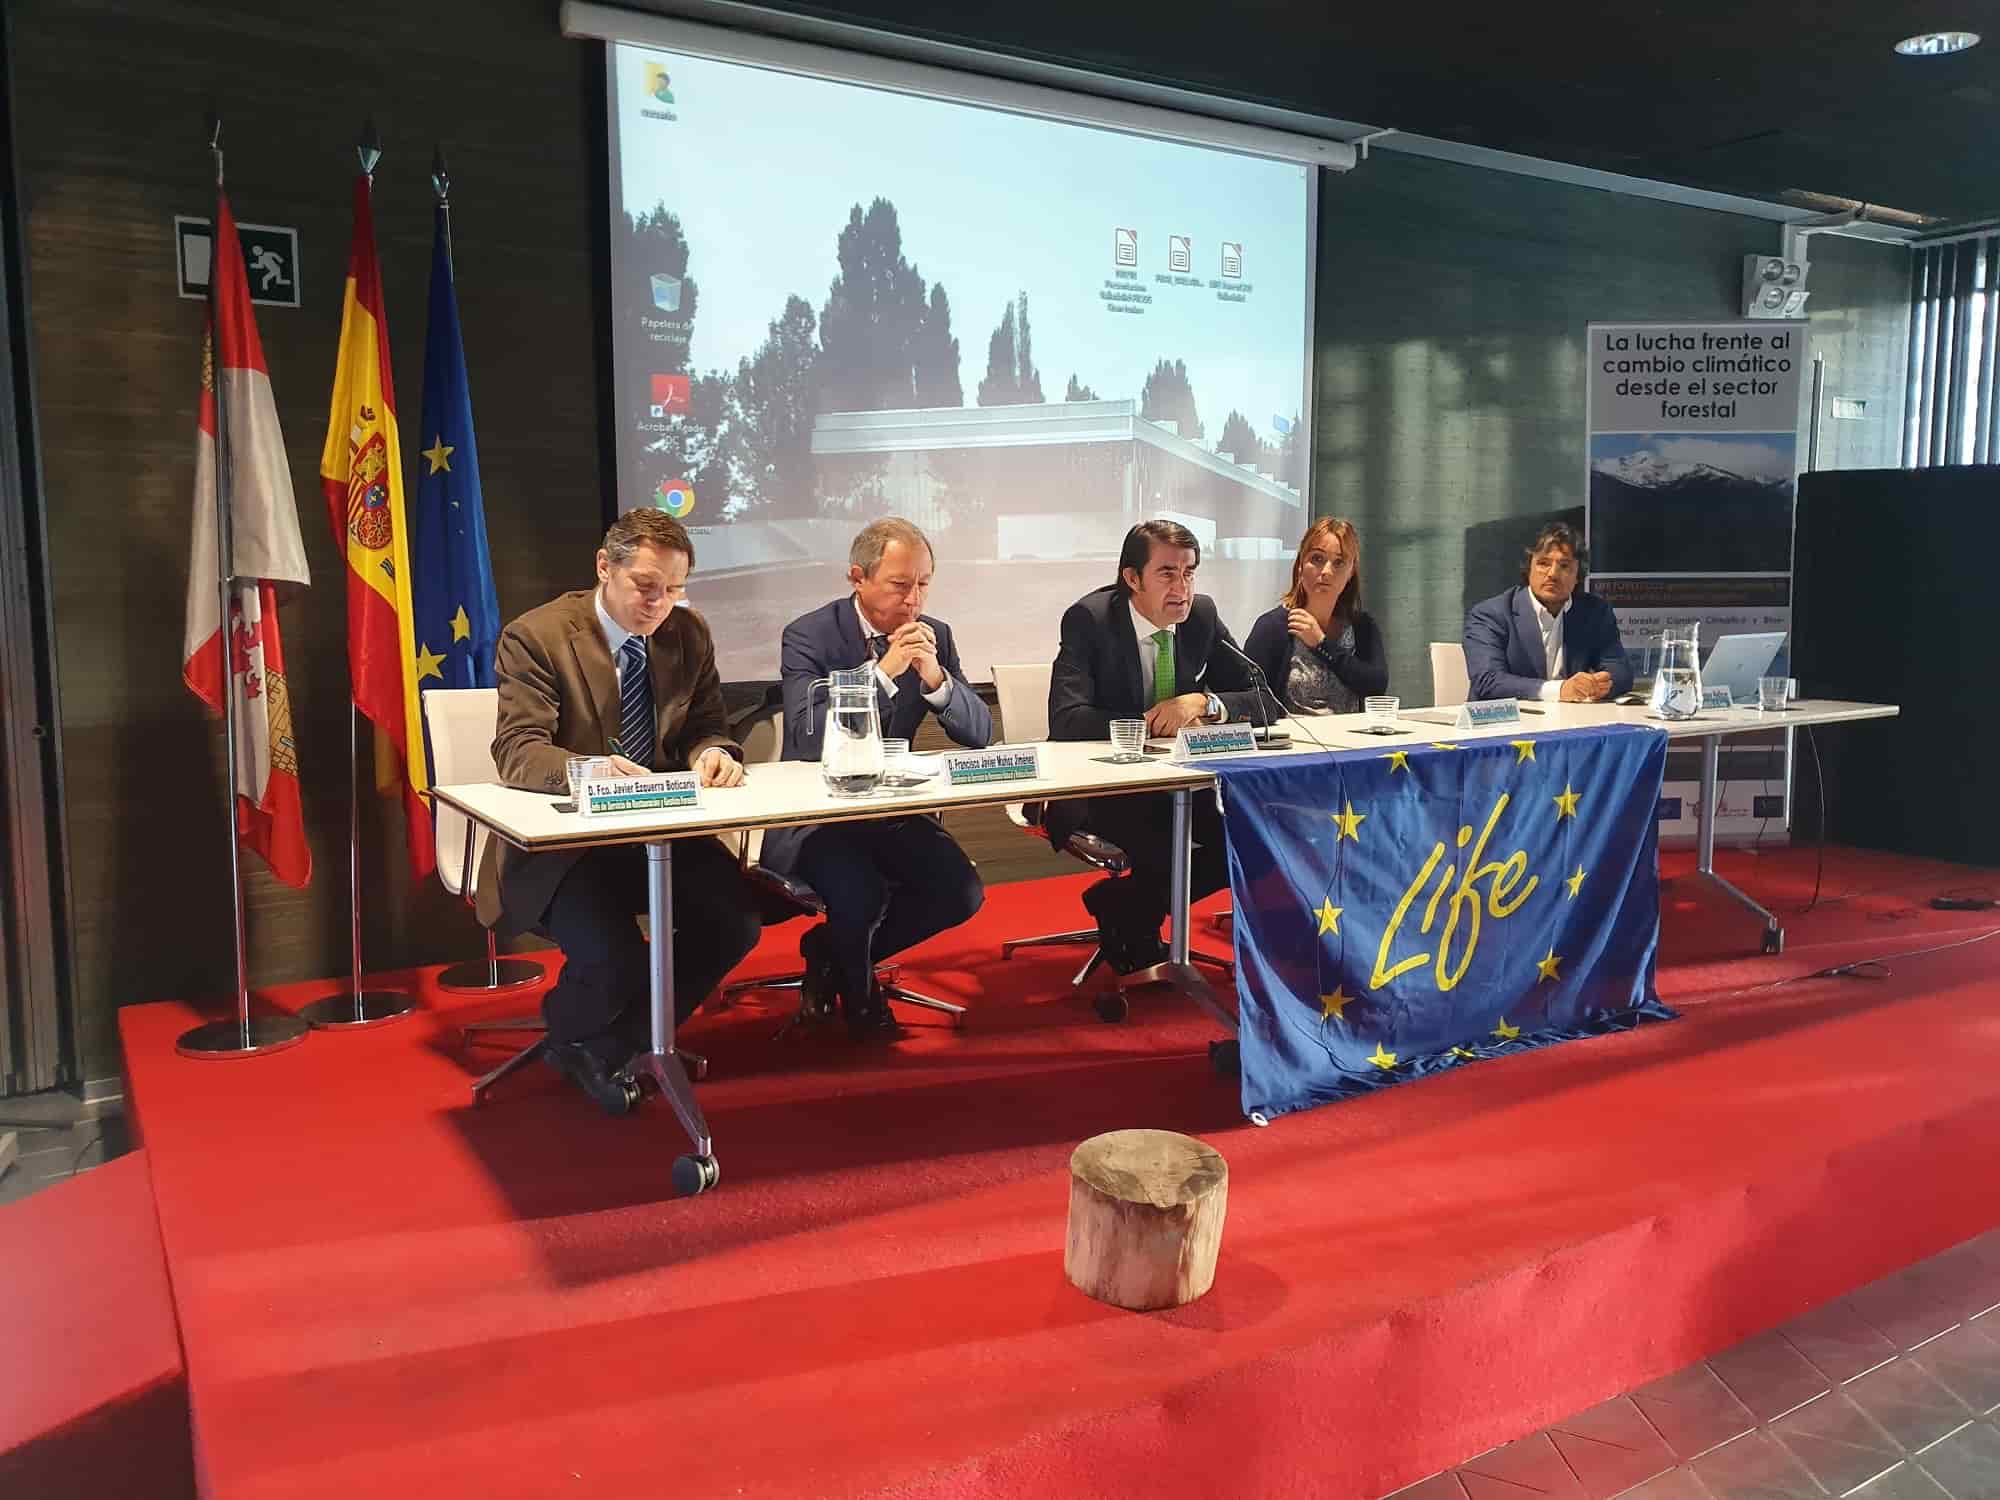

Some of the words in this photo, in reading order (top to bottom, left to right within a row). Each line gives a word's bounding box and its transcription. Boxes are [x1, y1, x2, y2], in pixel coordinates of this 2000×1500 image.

[1606, 333, 1629, 351] La
[1636, 333, 1696, 351] lucha
[1702, 332, 1763, 350] frente
[1770, 331, 1790, 350] al
[1602, 356, 1685, 374] cambio
[1692, 353, 1791, 373] climático
[1615, 378, 1681, 397] desde
[1688, 377, 1706, 396] el
[1712, 379, 1778, 396] sector
[1661, 400, 1737, 419] forestal
[587, 785, 596, 796] D.
[597, 784, 611, 796] Fco.
[613, 783, 634, 794] Javier
[665, 779, 696, 791] Boticario
[1369, 793, 1539, 991] Life
